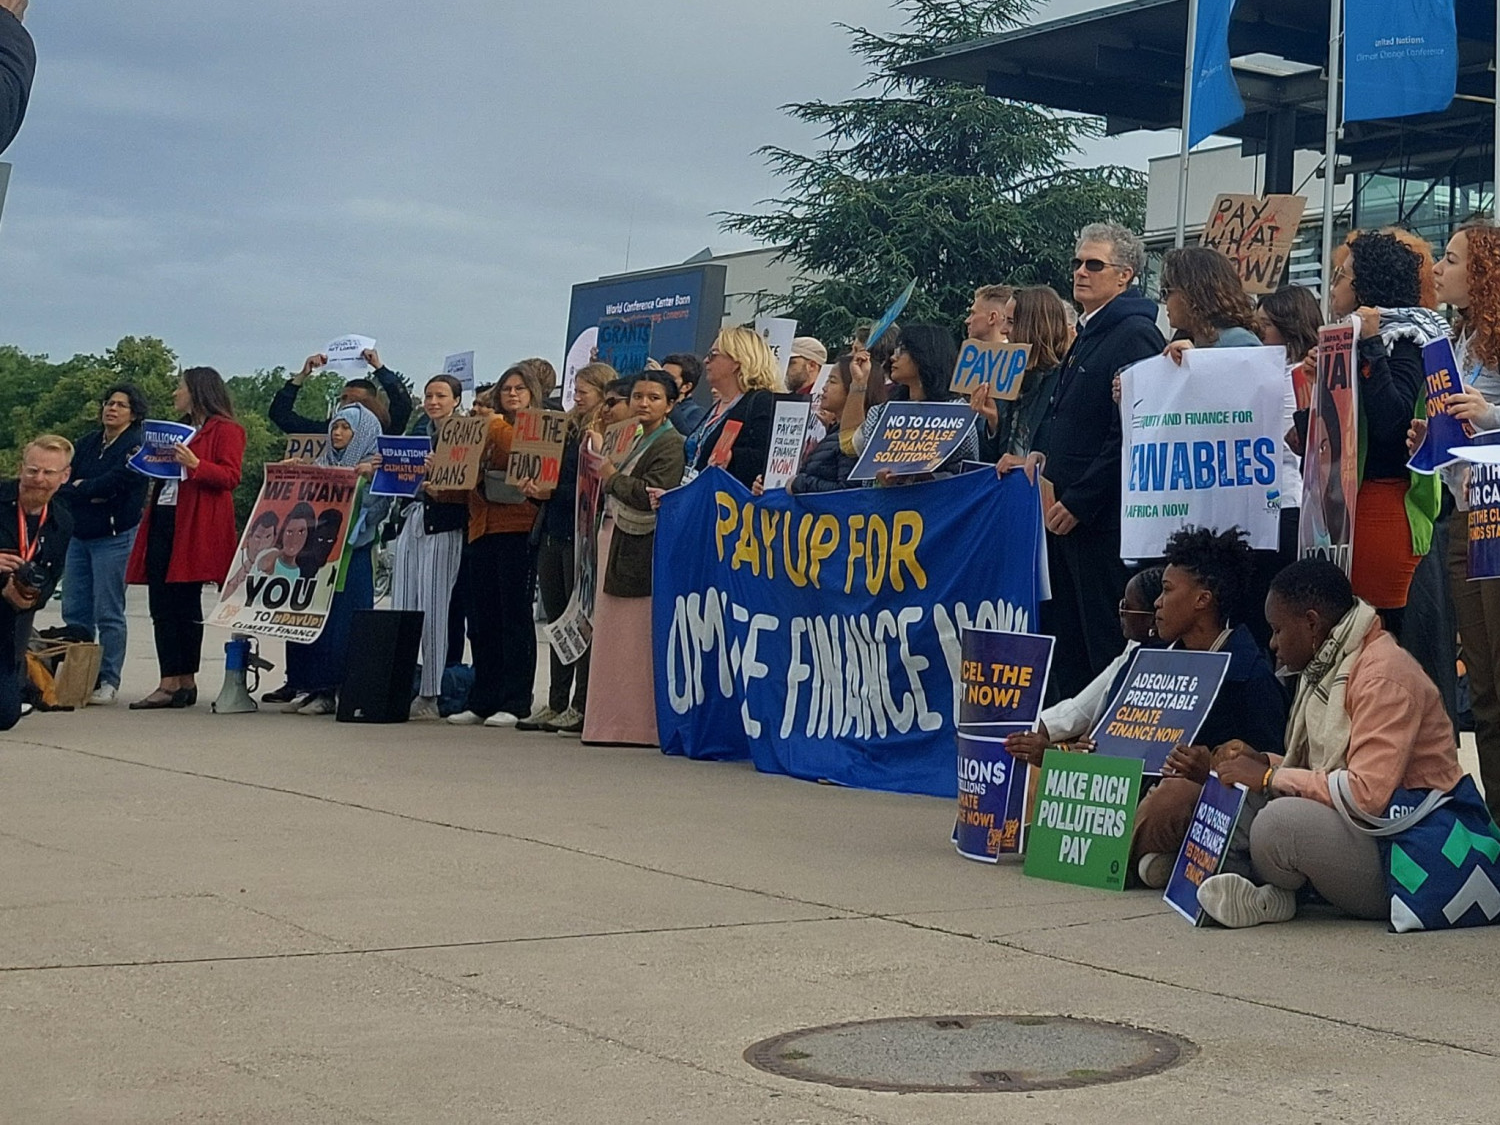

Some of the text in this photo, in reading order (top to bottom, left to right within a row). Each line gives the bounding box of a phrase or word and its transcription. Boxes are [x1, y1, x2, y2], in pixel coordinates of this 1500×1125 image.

[1212, 199, 1270, 230] PAY
[606, 295, 690, 315] World Conference Center Bonn
[887, 416, 964, 429] NO TO LOANS
[1162, 413, 1182, 425] AND
[1184, 411, 1229, 425] FINANCE
[1232, 411, 1253, 423] FOR
[442, 419, 484, 445] GRANTS
[542, 415, 564, 443] THE
[883, 429, 957, 441] NO TO FALSE
[288, 439, 327, 458] PAY
[382, 448, 428, 457] REPARATIONS
[450, 447, 468, 463] NOT
[886, 440, 940, 452] FINANCE
[770, 459, 794, 475] NOW!
[873, 451, 941, 463] SOLUTIONS!
[429, 464, 466, 485] LOANS
[264, 481, 354, 503] WE WANT
[1162, 503, 1188, 517] NOW
[844, 510, 927, 595] FOR
[245, 576, 317, 611] YOU
[254, 611, 270, 621] TO
[780, 607, 942, 740] FINANCE
[990, 663, 1033, 687] THE
[1131, 673, 1198, 691] ADEQUATE &
[968, 684, 1022, 709] NOW!
[1123, 691, 1198, 711] PREDICTABLE
[1116, 705, 1162, 725] CLIMATE
[1106, 721, 1184, 743] FINANCE NOW!
[1045, 769, 1130, 805] MAKE RICH
[967, 811, 995, 827] NOW!
[1038, 800, 1126, 838] POLLUTERS
[1059, 835, 1092, 865] PAY
